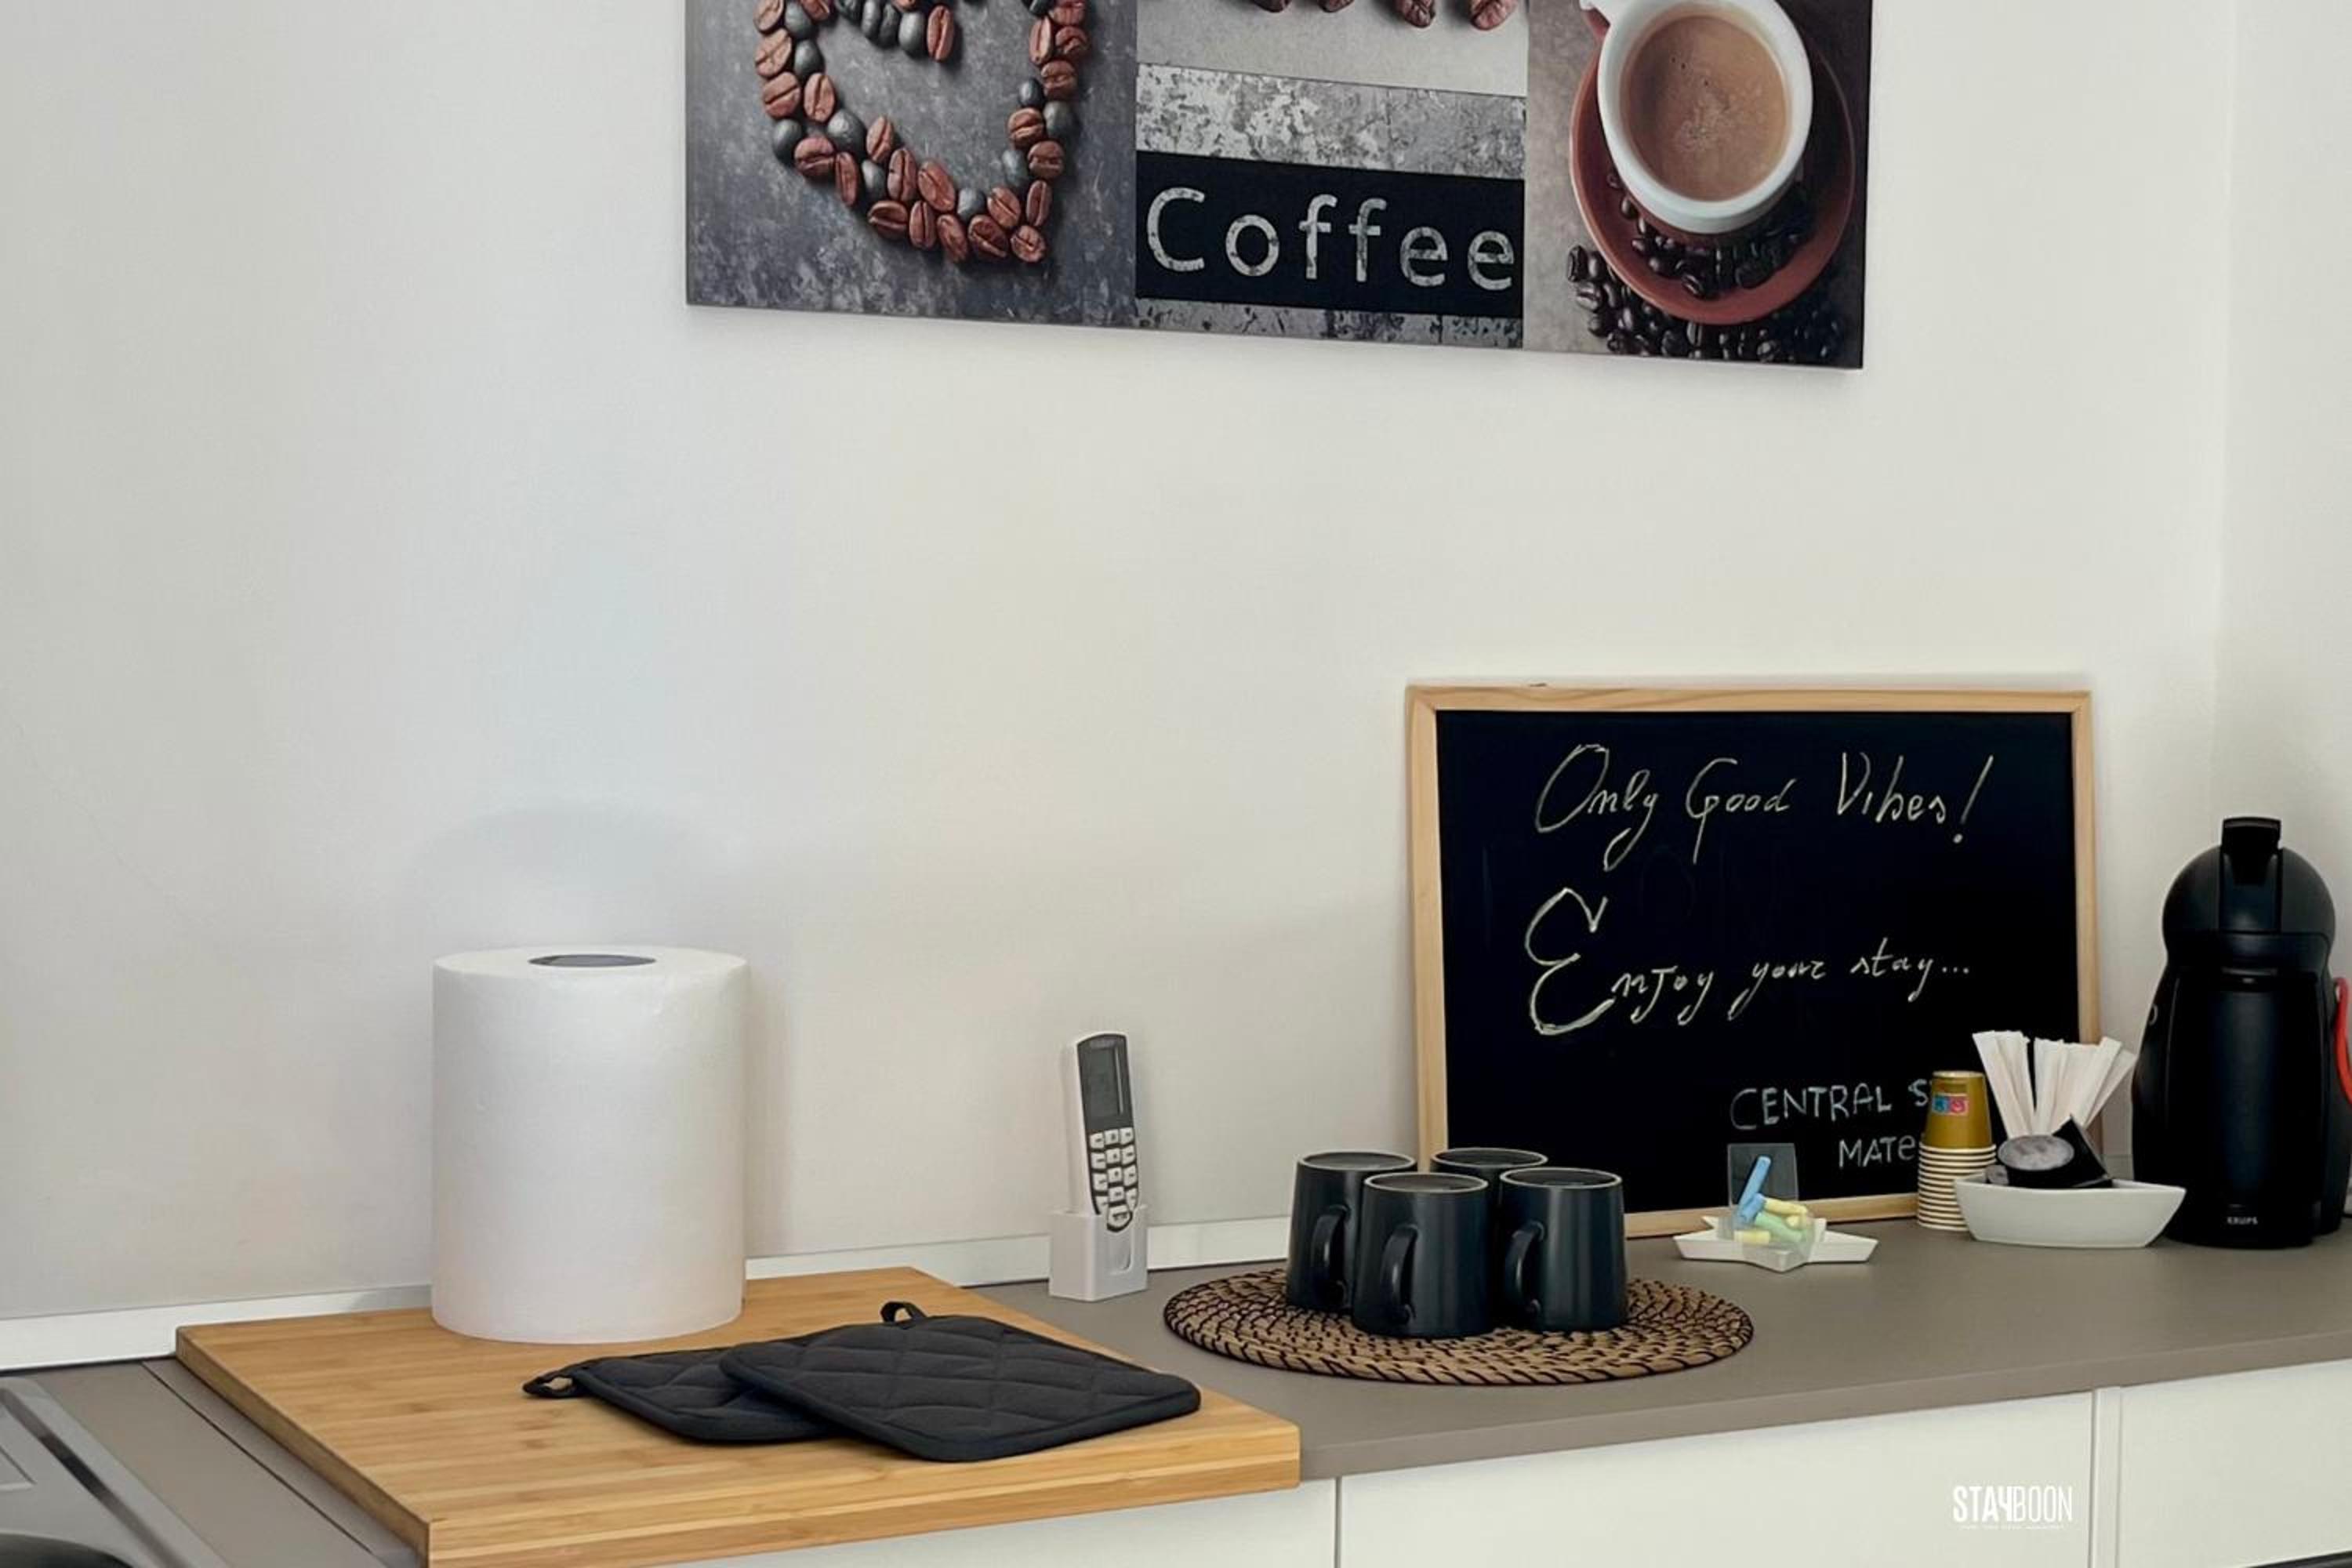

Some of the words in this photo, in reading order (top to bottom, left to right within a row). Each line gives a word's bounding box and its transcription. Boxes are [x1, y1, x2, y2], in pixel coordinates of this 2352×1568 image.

[1146, 187, 1515, 291] Coffee
[1534, 743, 1659, 870] Only
[1685, 757, 1797, 863] Good
[1835, 751, 1994, 844] Vibes!
[1726, 960, 1827, 1022] your
[1730, 1083, 1892, 1130] CENTRAL
[1908, 1079, 1931, 1107] S
